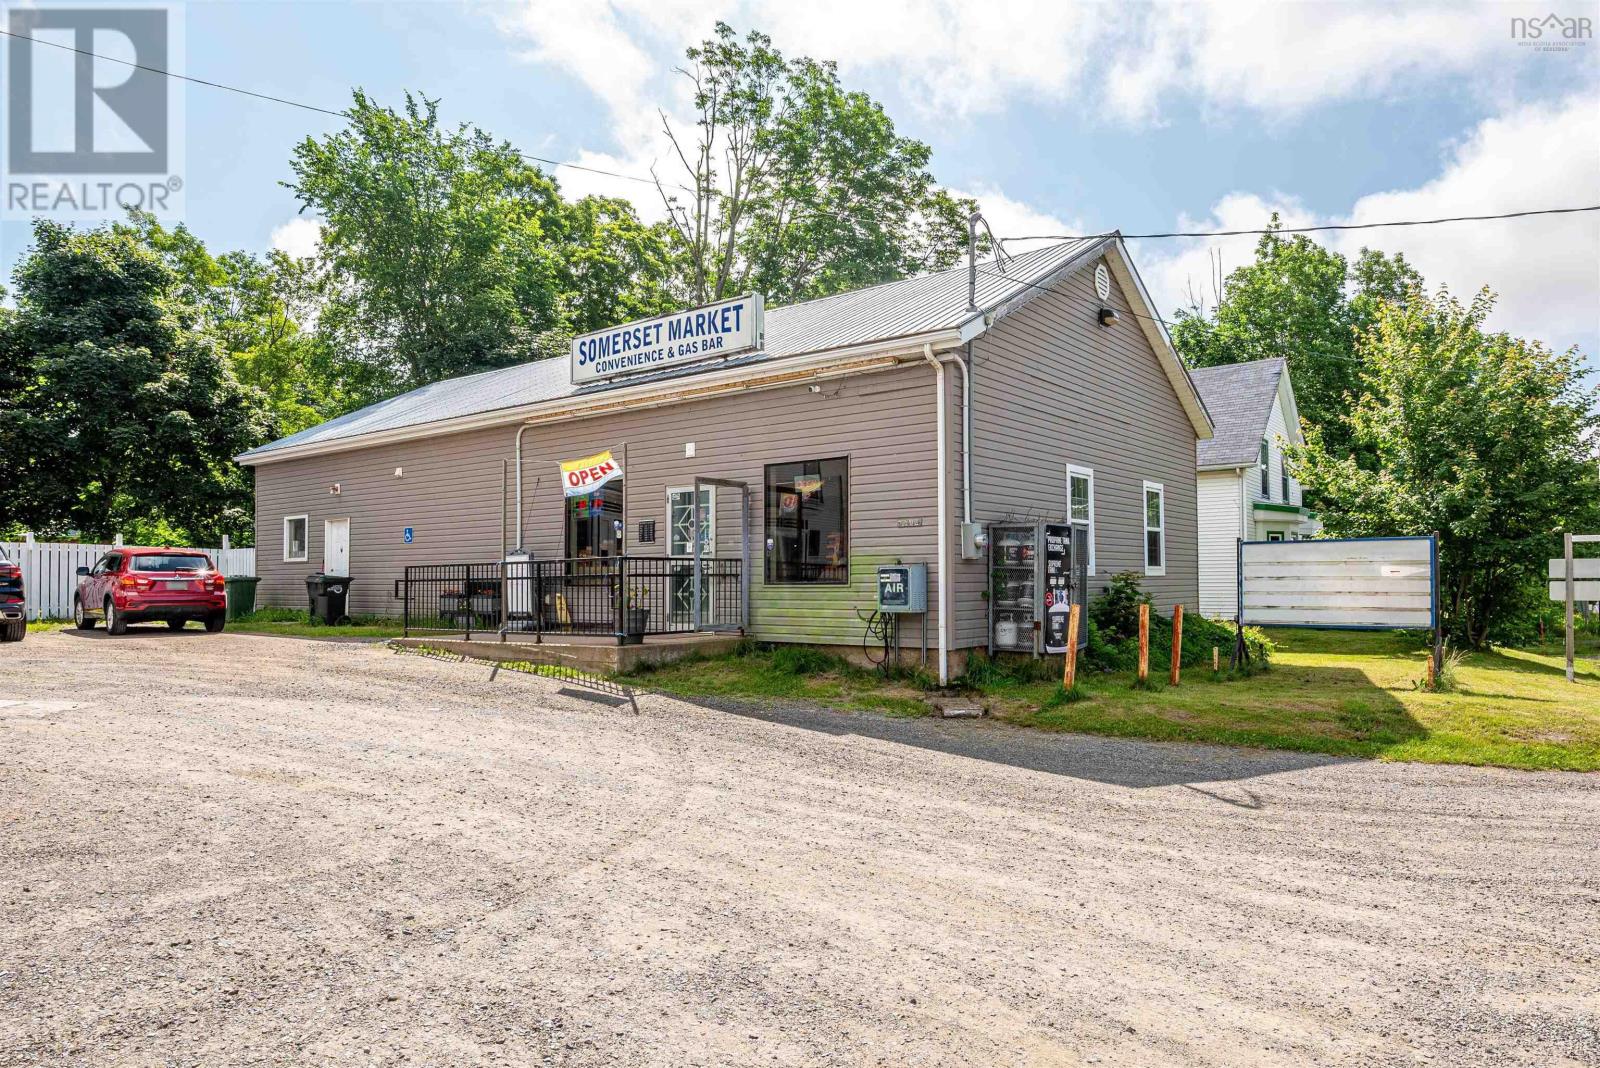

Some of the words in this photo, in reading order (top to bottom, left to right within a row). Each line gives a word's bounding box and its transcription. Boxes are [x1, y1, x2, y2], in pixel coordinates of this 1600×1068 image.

[578, 323, 663, 366] SOMERSET
[668, 303, 744, 341] MARKET
[595, 348, 664, 373] CONVENIENCE
[667, 346, 675, 359] &
[678, 341, 698, 356] GAS
[702, 336, 723, 351] BAR
[568, 461, 615, 487] OPEN
[884, 583, 904, 593] AIR
